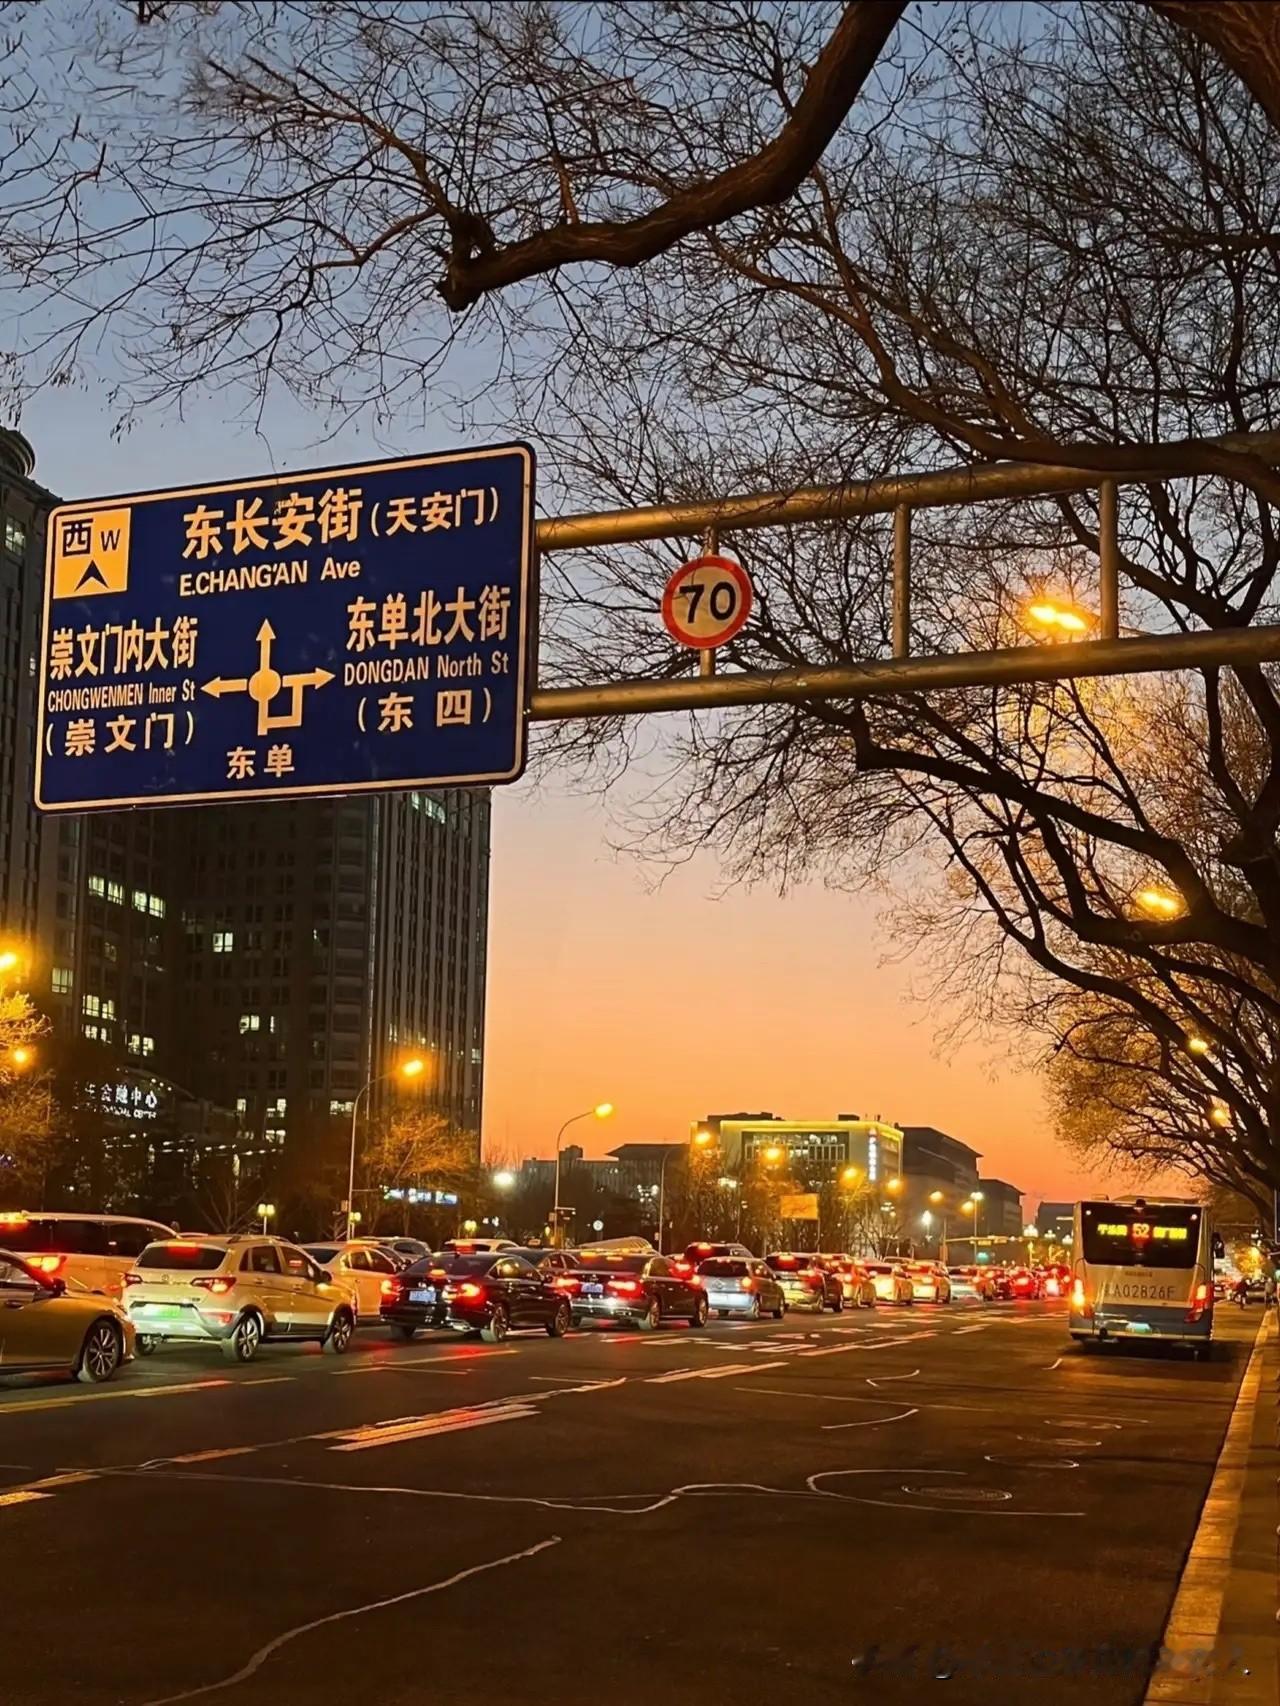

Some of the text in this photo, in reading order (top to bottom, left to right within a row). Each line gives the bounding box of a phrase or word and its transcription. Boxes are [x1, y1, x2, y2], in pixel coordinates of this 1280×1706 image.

[62, 518, 121, 557] 西 W
[320, 557, 361, 581] Ave
[346, 585, 511, 652] 东单北大街
[679, 581, 736, 624] 70
[50, 616, 198, 680] 崇文门内大街
[344, 650, 509, 686] DONGDAN North St
[48, 678, 195, 712] CHONGWENMEN Inner St
[226, 744, 295, 780] 东单
[1132, 1223, 1150, 1238] 52
[1104, 1283, 1177, 1300] A02826F
